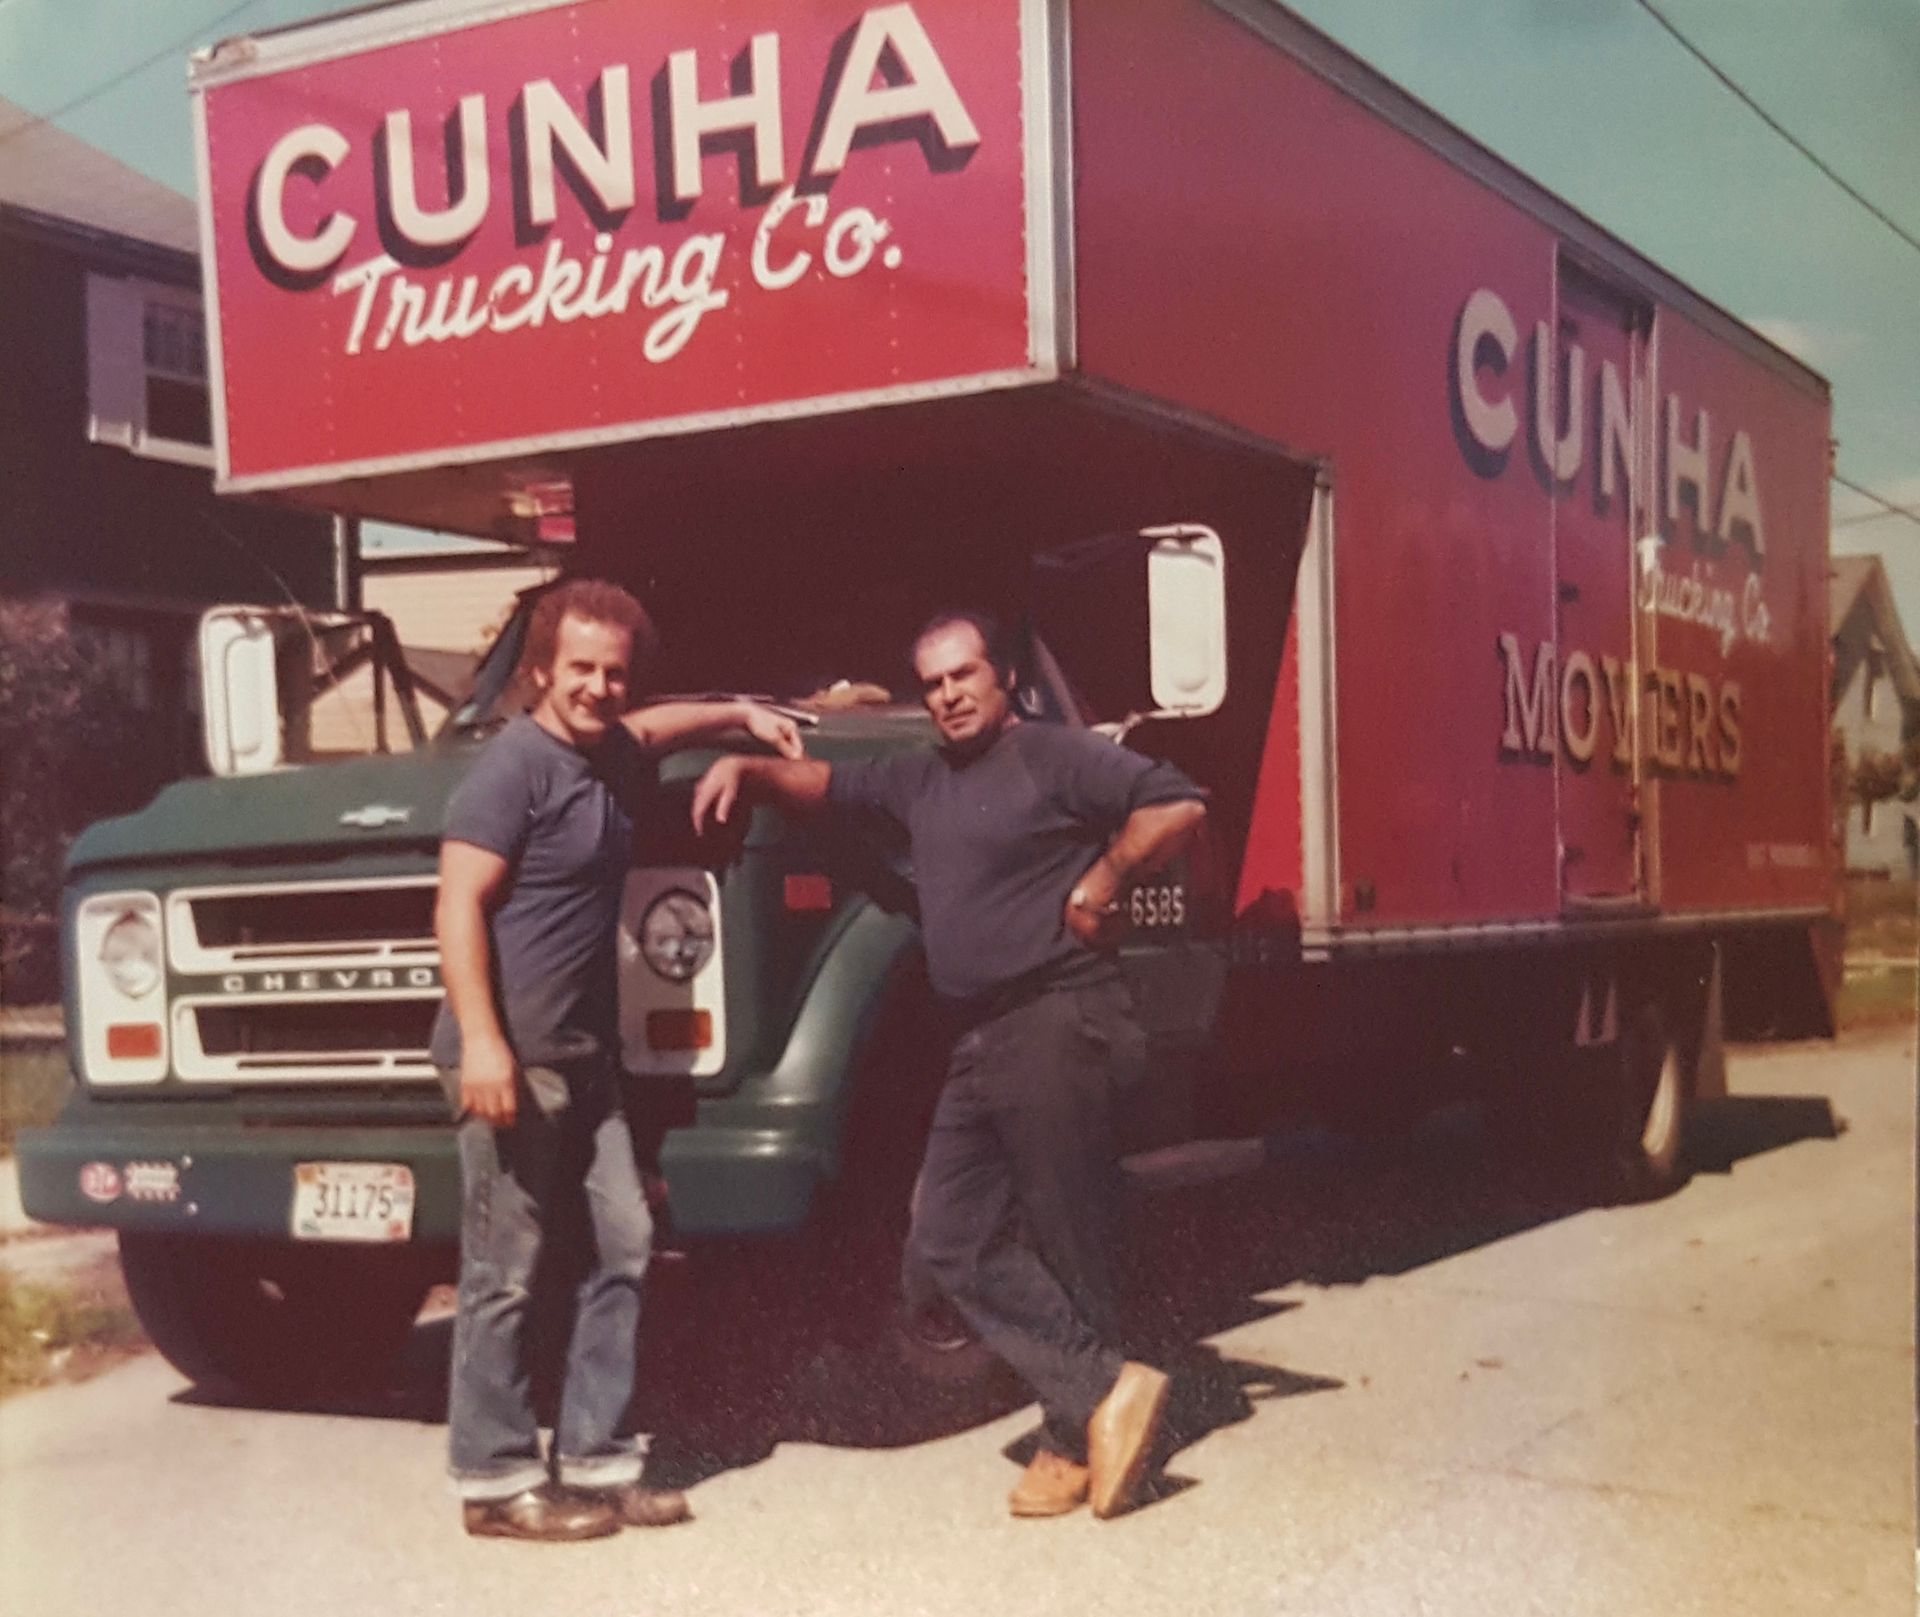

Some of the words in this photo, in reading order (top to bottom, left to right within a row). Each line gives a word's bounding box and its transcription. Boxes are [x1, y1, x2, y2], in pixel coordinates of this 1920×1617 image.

[252, 2, 981, 274] CUNHA
[332, 232, 727, 363] Trucking
[751, 184, 904, 291] Co.
[1456, 287, 1766, 555] CUNHA
[1500, 632, 1742, 776] MOVERS
[313, 1183, 393, 1218] 31175
